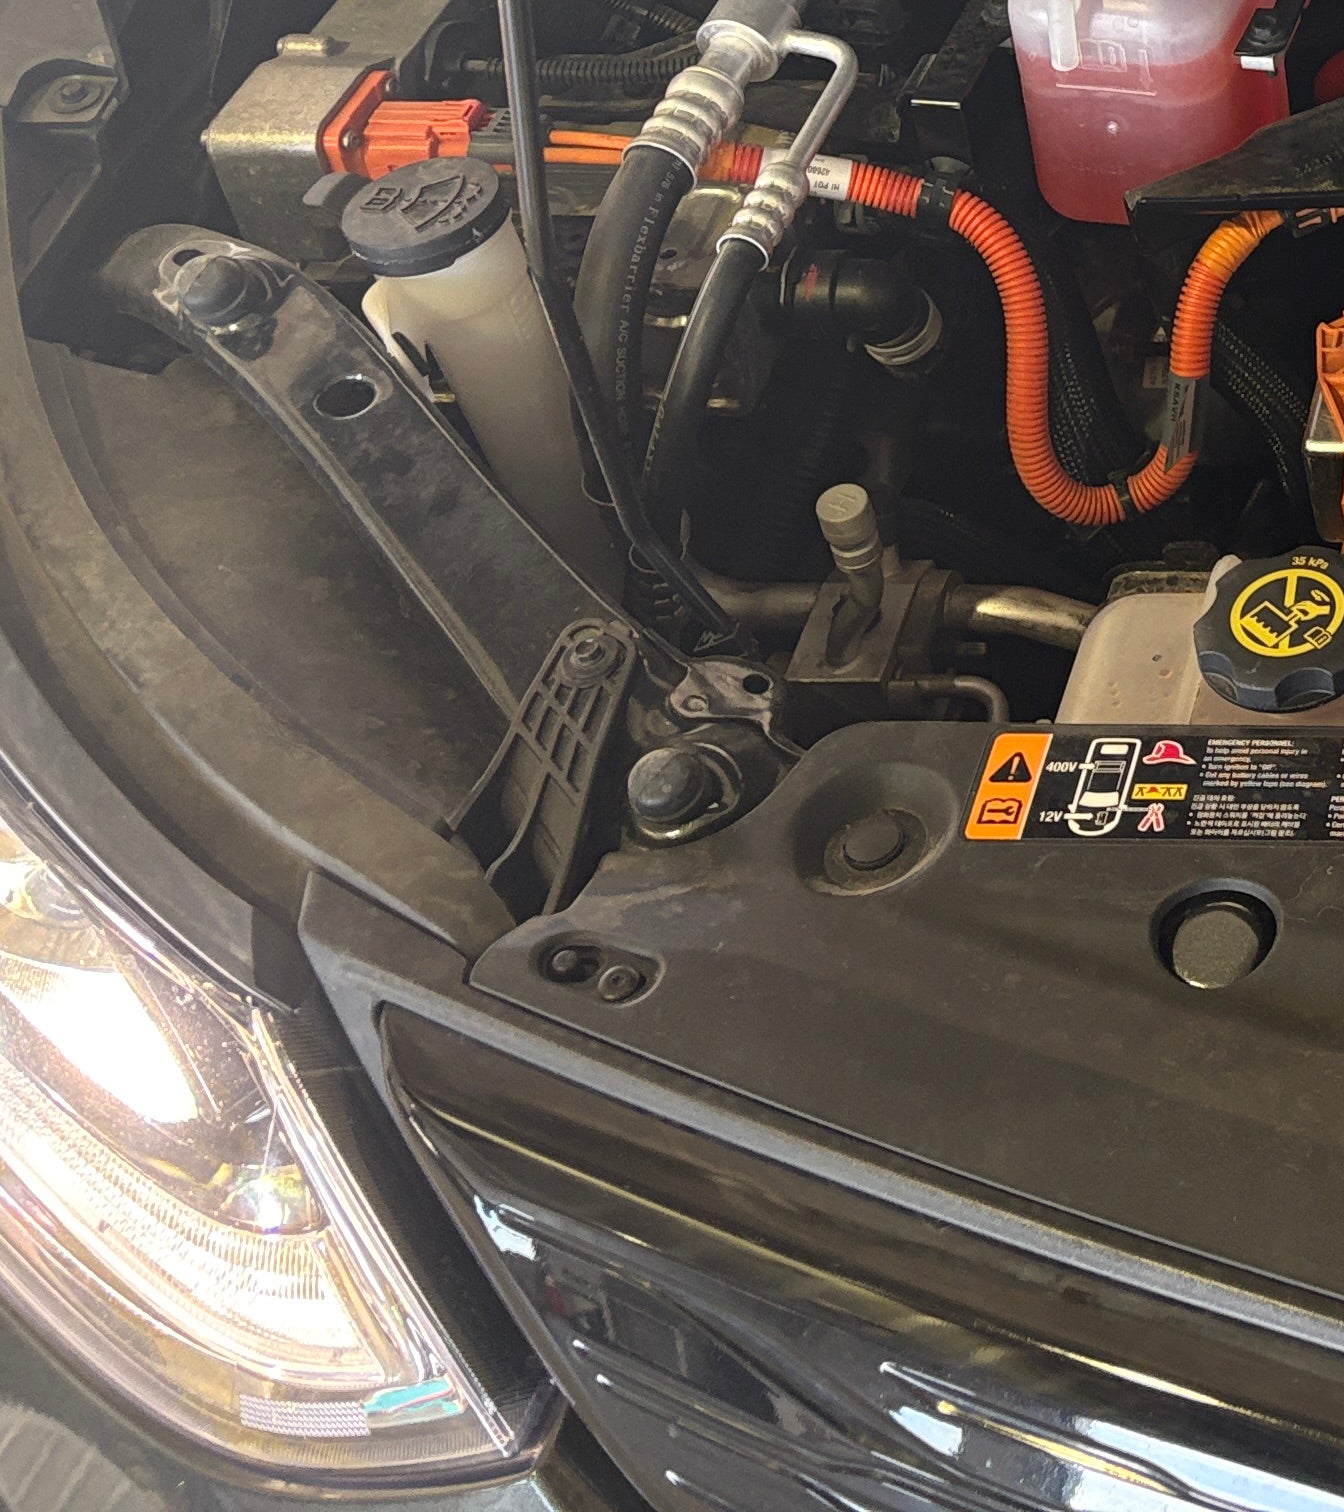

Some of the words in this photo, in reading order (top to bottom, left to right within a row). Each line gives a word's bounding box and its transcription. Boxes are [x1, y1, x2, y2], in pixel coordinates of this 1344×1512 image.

[620, 205, 660, 313] Flexbarrier
[1291, 556, 1307, 566] 35
[1308, 557, 1329, 570] kPa
[1045, 761, 1078, 772] 400V
[1039, 810, 1063, 822] 12V
